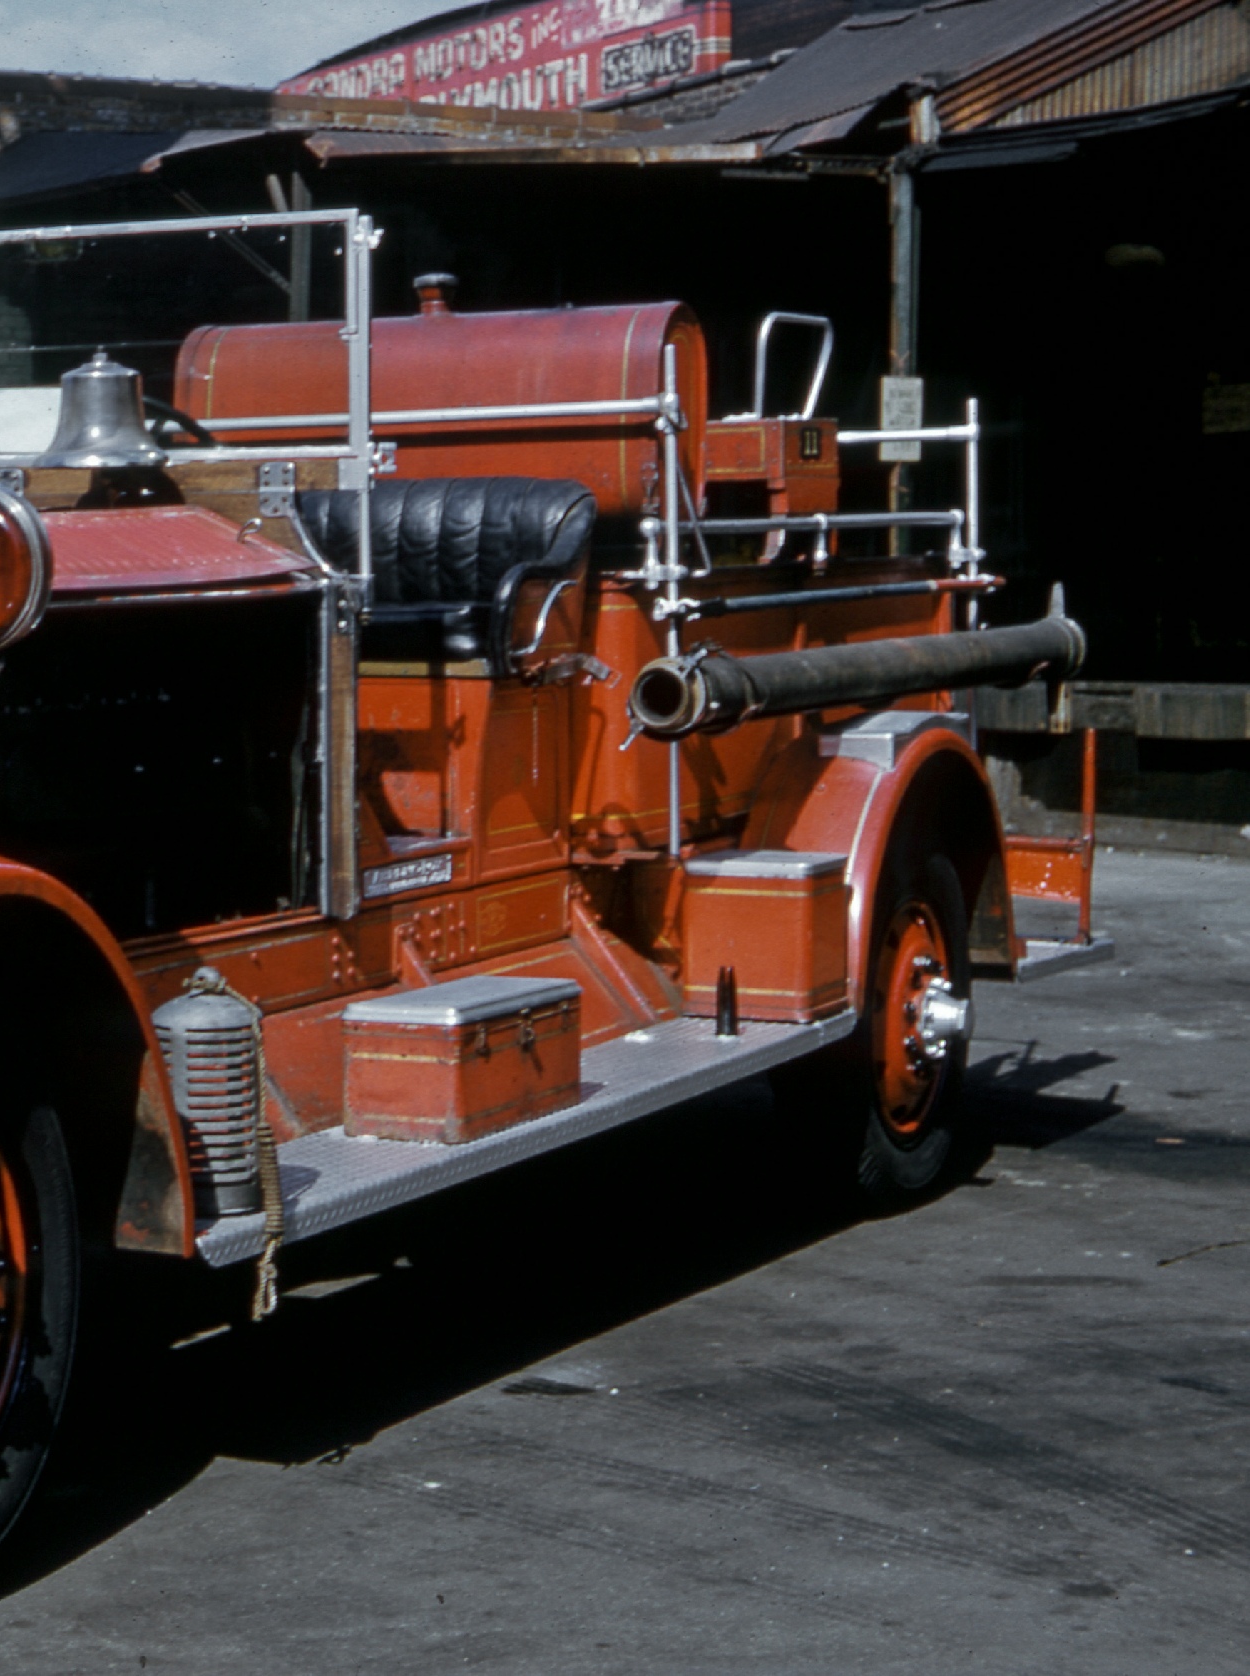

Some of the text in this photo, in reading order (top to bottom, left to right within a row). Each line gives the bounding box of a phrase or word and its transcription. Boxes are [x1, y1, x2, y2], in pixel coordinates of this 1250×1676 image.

[413, 17, 524, 82] MOTORS
[419, 32, 690, 110] MOUTH SERVICE
